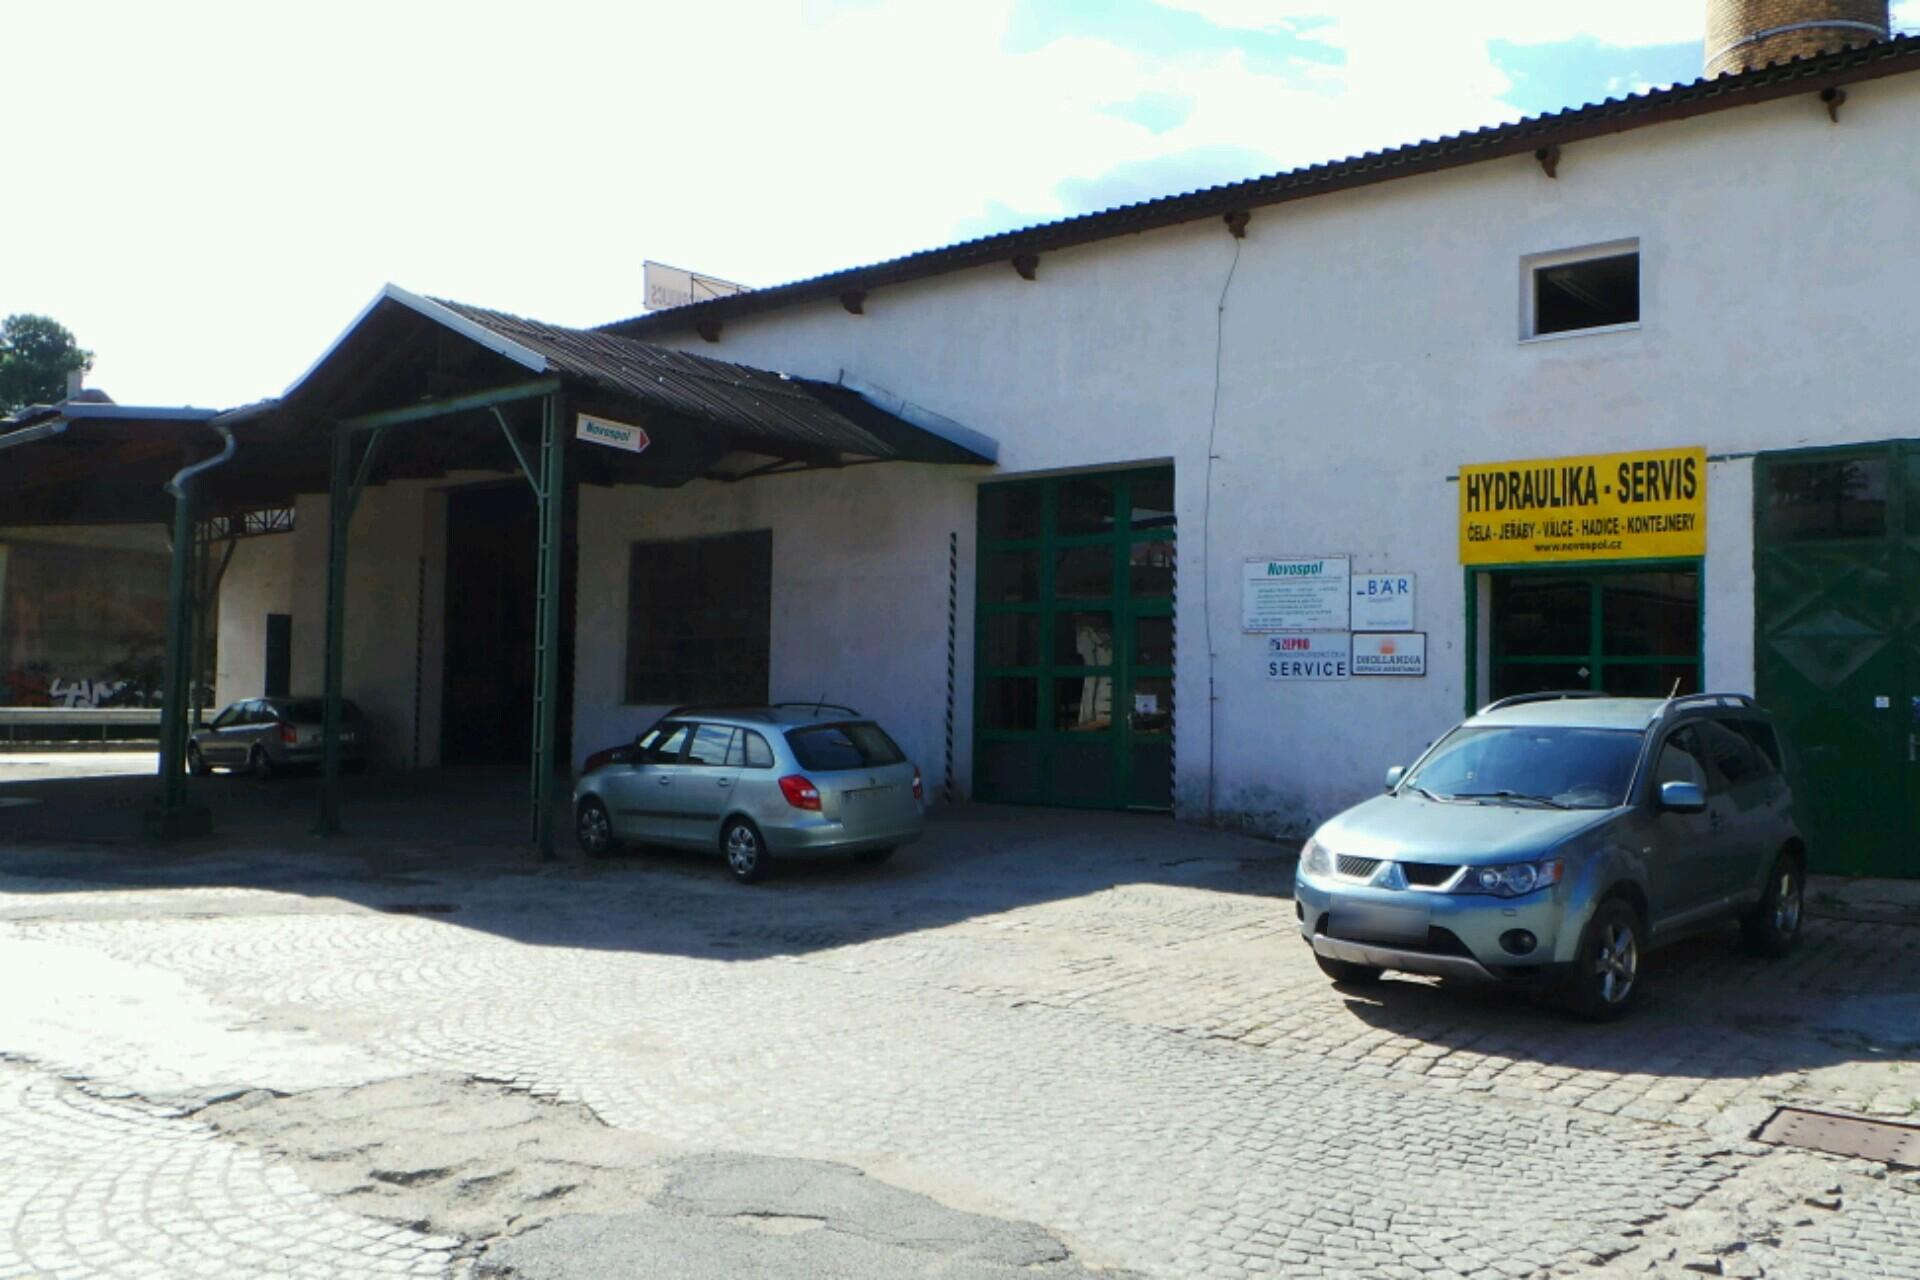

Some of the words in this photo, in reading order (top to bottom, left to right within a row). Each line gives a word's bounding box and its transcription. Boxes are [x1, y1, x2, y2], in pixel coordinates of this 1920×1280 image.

[1467, 466, 1598, 512] HYDRAULIKA
[1617, 457, 1697, 504] SERVIS
[1582, 518, 1619, 535] HADICE
[1627, 513, 1695, 534] KONTEJNERY
[1267, 561, 1324, 576] Novospol
[1269, 661, 1346, 676] SERVICE
